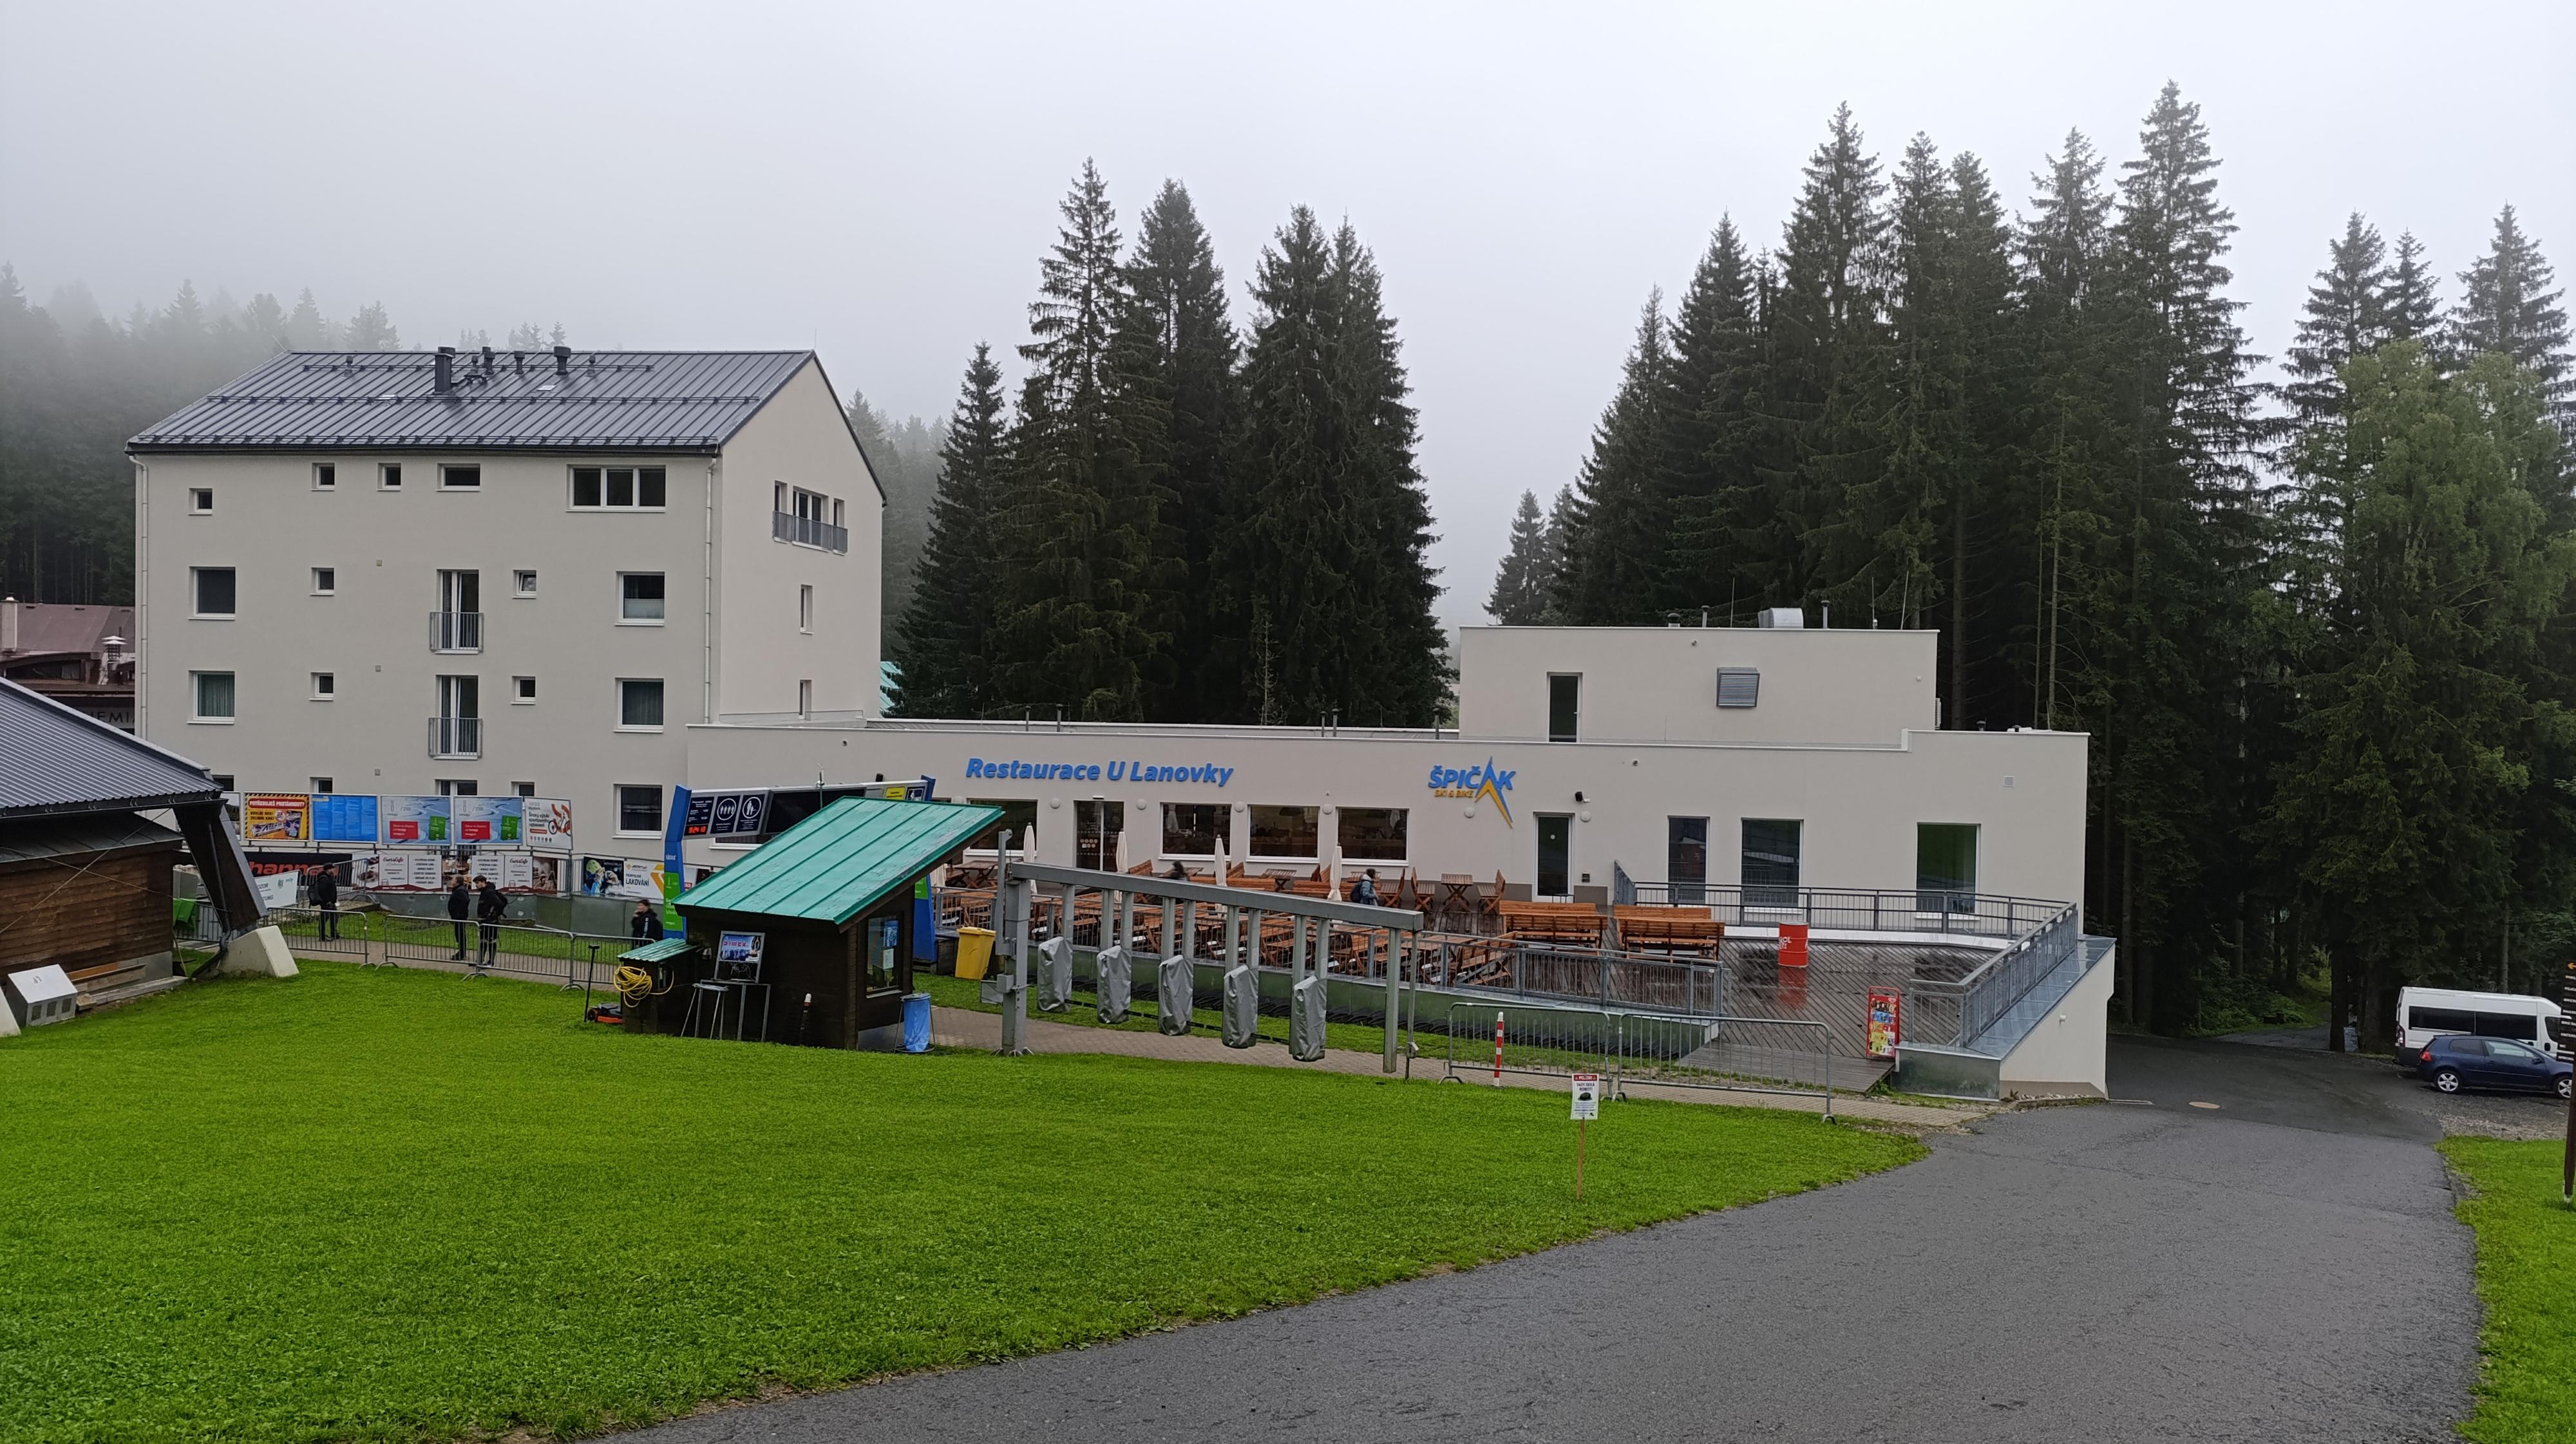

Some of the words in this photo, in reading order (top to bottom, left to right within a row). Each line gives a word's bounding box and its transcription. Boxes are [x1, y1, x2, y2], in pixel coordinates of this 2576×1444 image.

[965, 758, 1101, 781] Restaurace
[1107, 760, 1126, 782] U
[1130, 760, 1234, 787] Lanovky
[1434, 789, 1447, 798] SKI
[1455, 790, 1475, 798] BIKE
